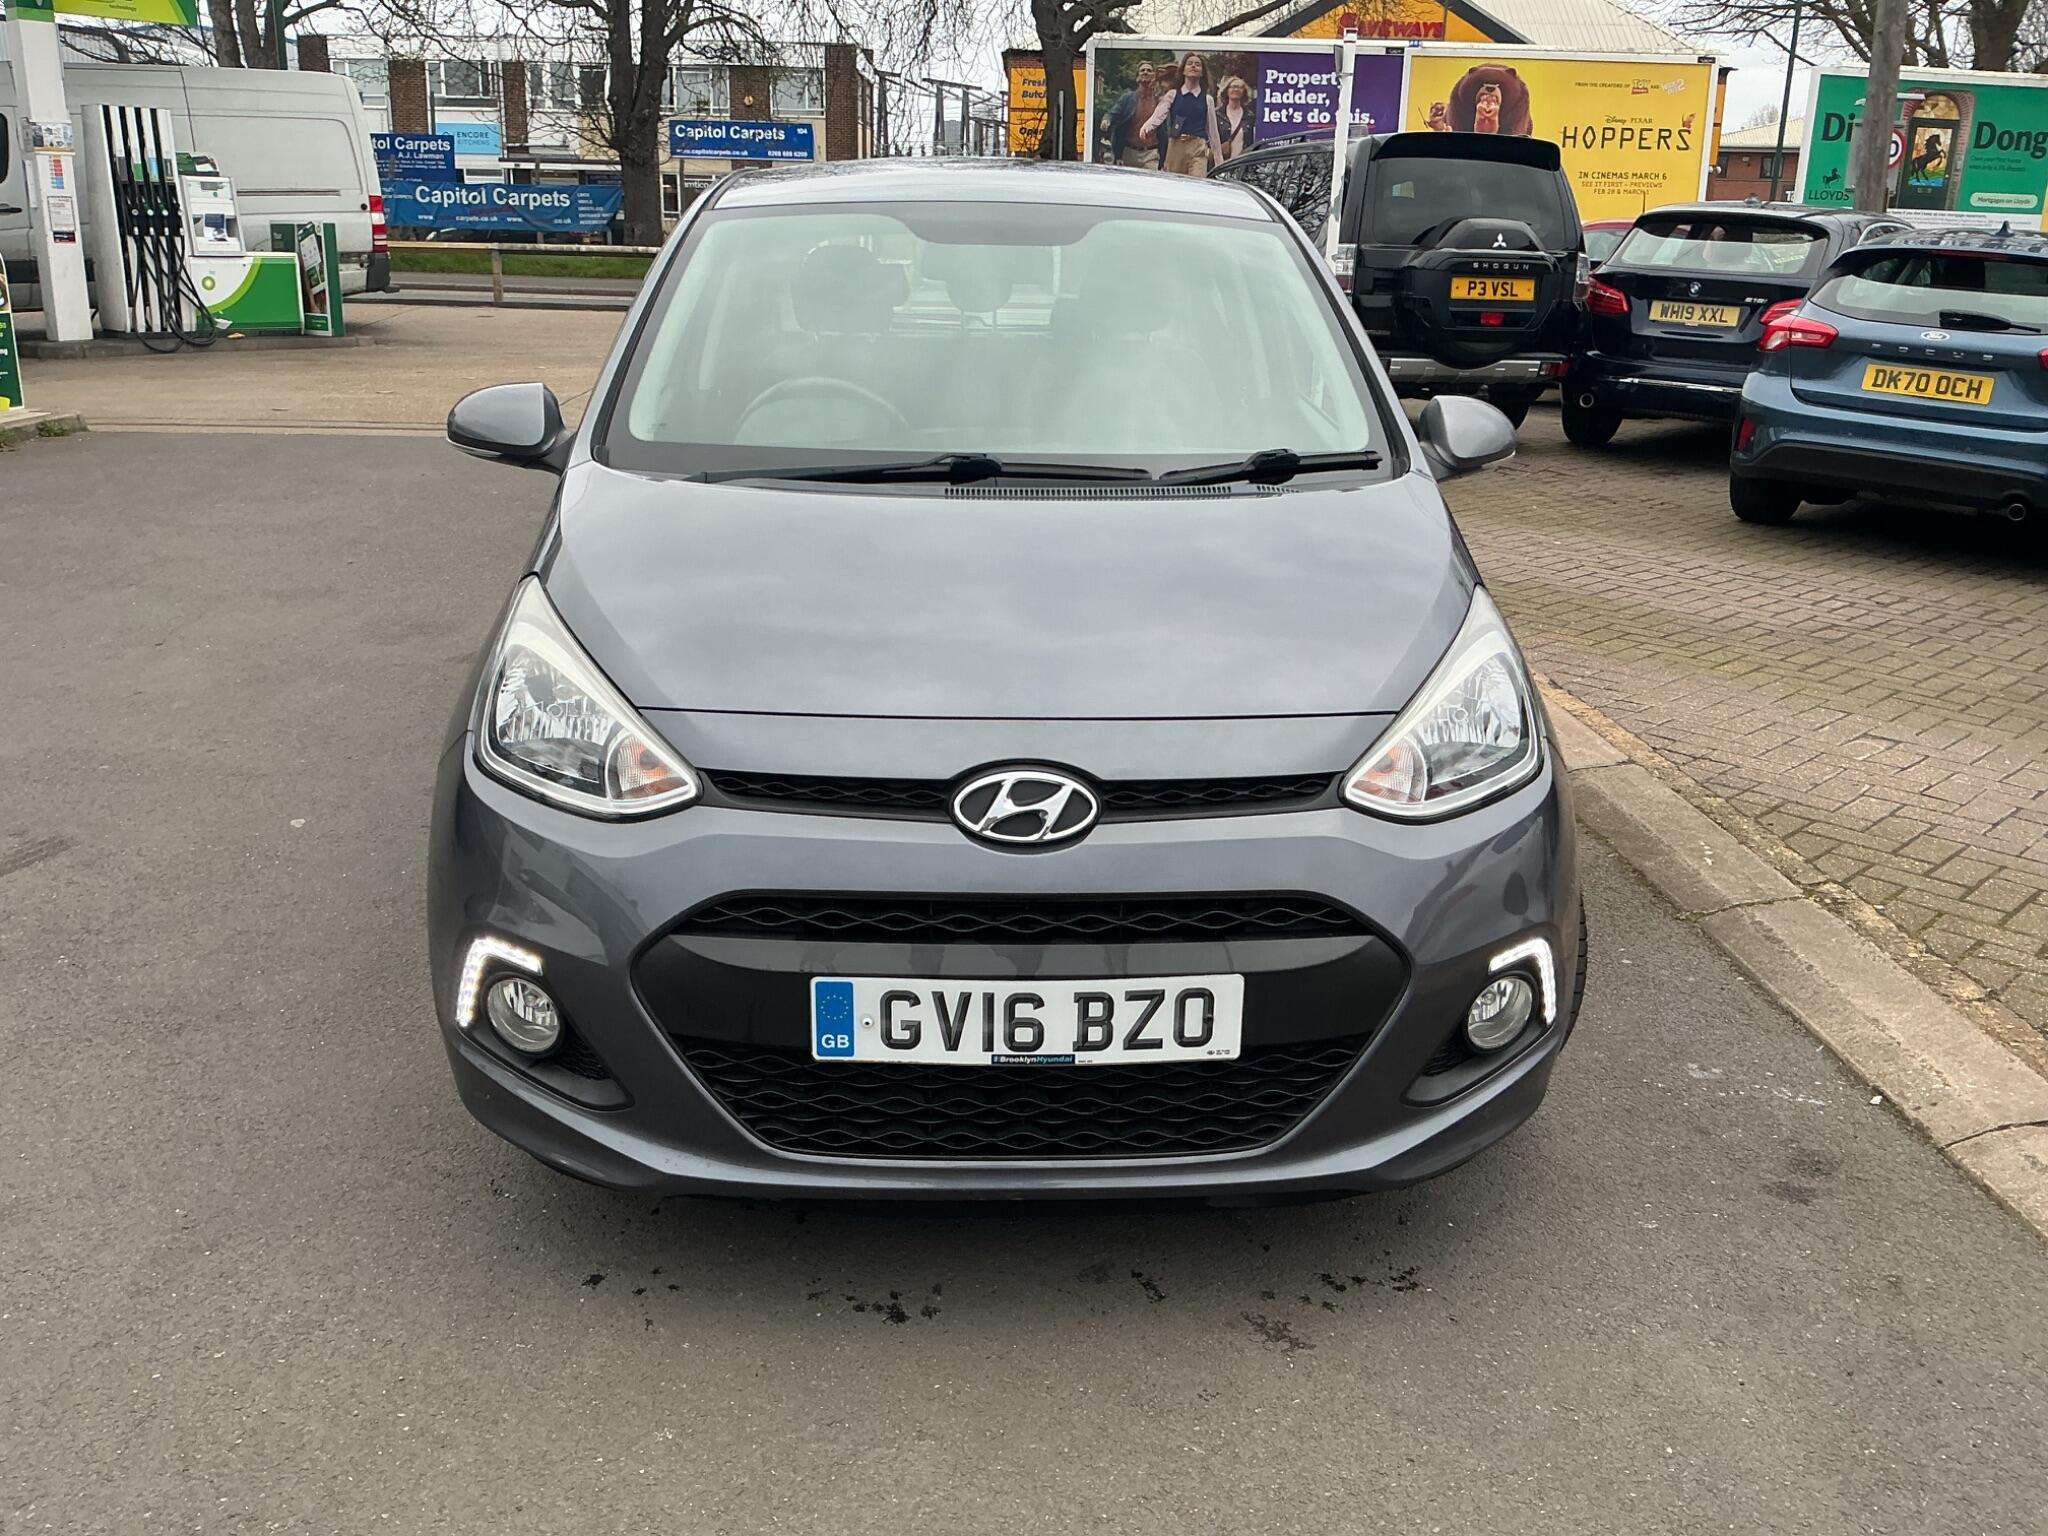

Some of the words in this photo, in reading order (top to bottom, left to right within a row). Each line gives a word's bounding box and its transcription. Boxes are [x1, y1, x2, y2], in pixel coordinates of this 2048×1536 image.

[1264, 88, 1330, 107] ladder,
[1306, 108, 1331, 124] do
[1335, 108, 1375, 125] is.
[675, 124, 726, 140] Capitol
[729, 125, 786, 142] Carpets
[1821, 112, 1857, 142] Di
[394, 136, 451, 152] Carpets
[1562, 125, 1692, 151] HOPPERS
[1974, 120, 2048, 159] Dong
[1591, 171, 1629, 180] CINEMAS
[1632, 172, 1659, 180] MARCH
[415, 185, 487, 208] Capitol
[492, 187, 571, 210] Carpets
[1808, 190, 1850, 201] LLOYDS
[1472, 262, 1530, 270] SHOGUN
[1467, 279, 1487, 297] P3
[1491, 279, 1519, 297] VSL
[1660, 303, 1695, 321] WH19
[1696, 306, 1728, 323] XXL
[1871, 368, 1931, 393] DK70
[1934, 375, 1984, 400] OCH
[879, 989, 1045, 1052] GV16
[1072, 987, 1215, 1052] BZO
[821, 1034, 850, 1048] GB
